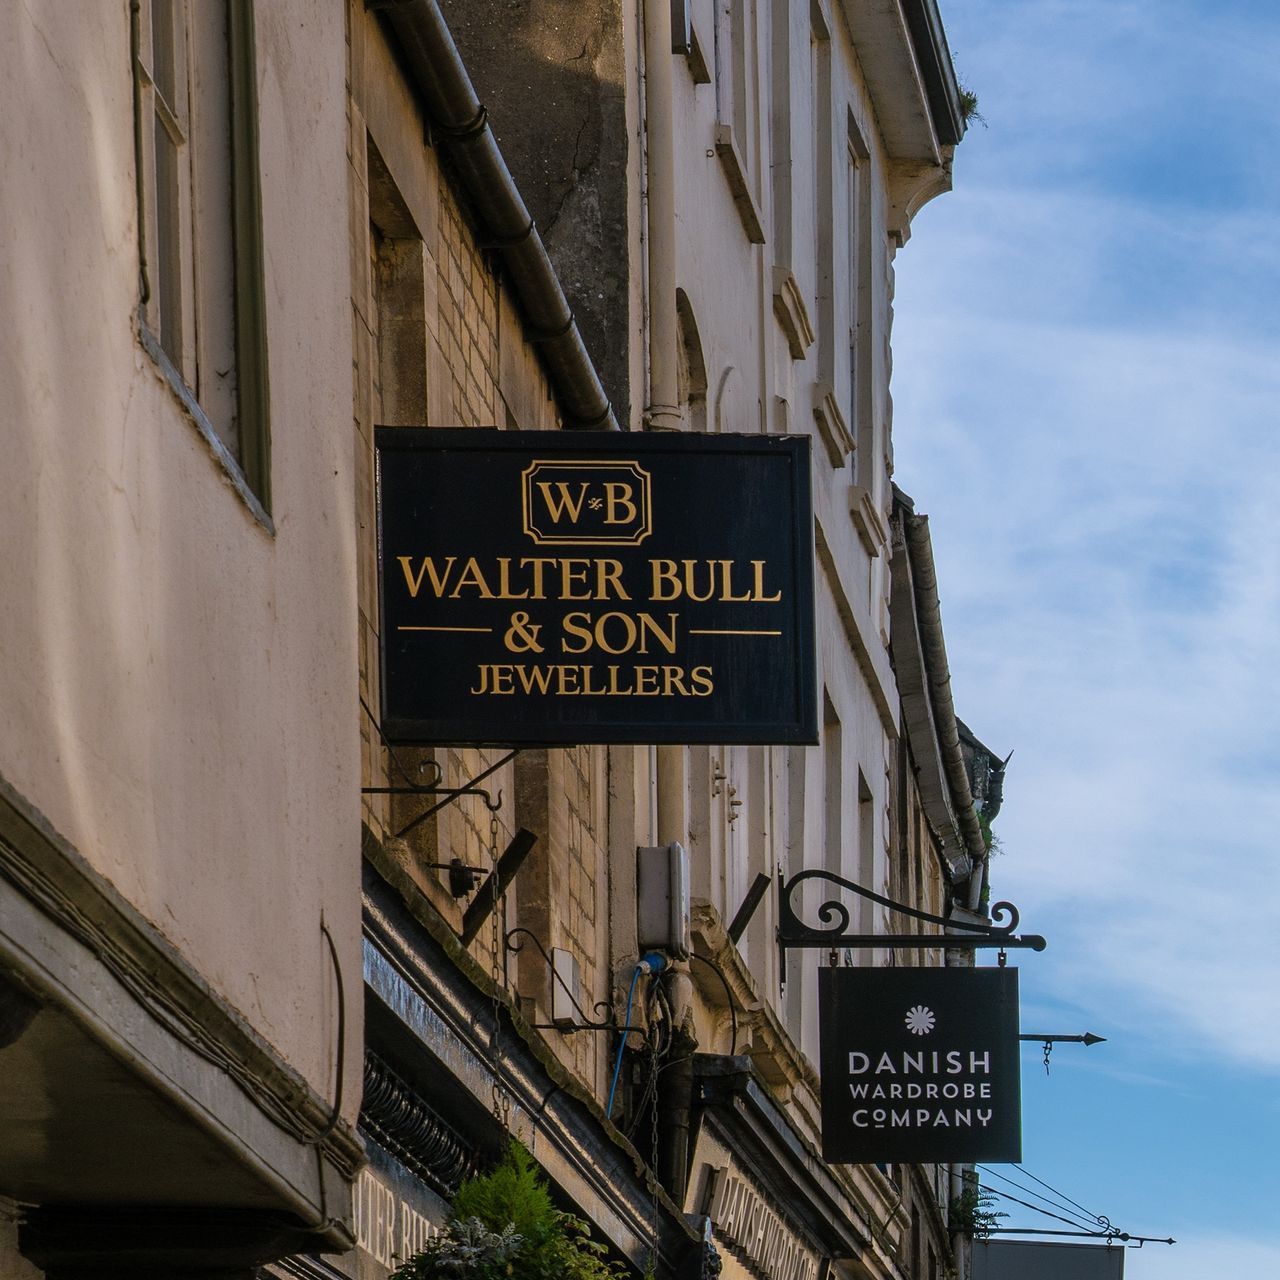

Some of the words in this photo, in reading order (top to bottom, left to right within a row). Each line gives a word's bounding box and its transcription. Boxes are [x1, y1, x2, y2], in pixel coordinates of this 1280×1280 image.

[396, 556, 631, 602] WALTER
[651, 559, 783, 604] BULL
[504, 610, 547, 655] &
[561, 611, 680, 655] SON
[470, 663, 715, 698] JEWELLERS
[848, 1051, 991, 1076] DANISH
[849, 1082, 993, 1100] WARDROBE
[851, 1108, 994, 1129] COMPANY
[352, 1169, 397, 1273] LTER
[716, 1174, 772, 1262] DANISH
